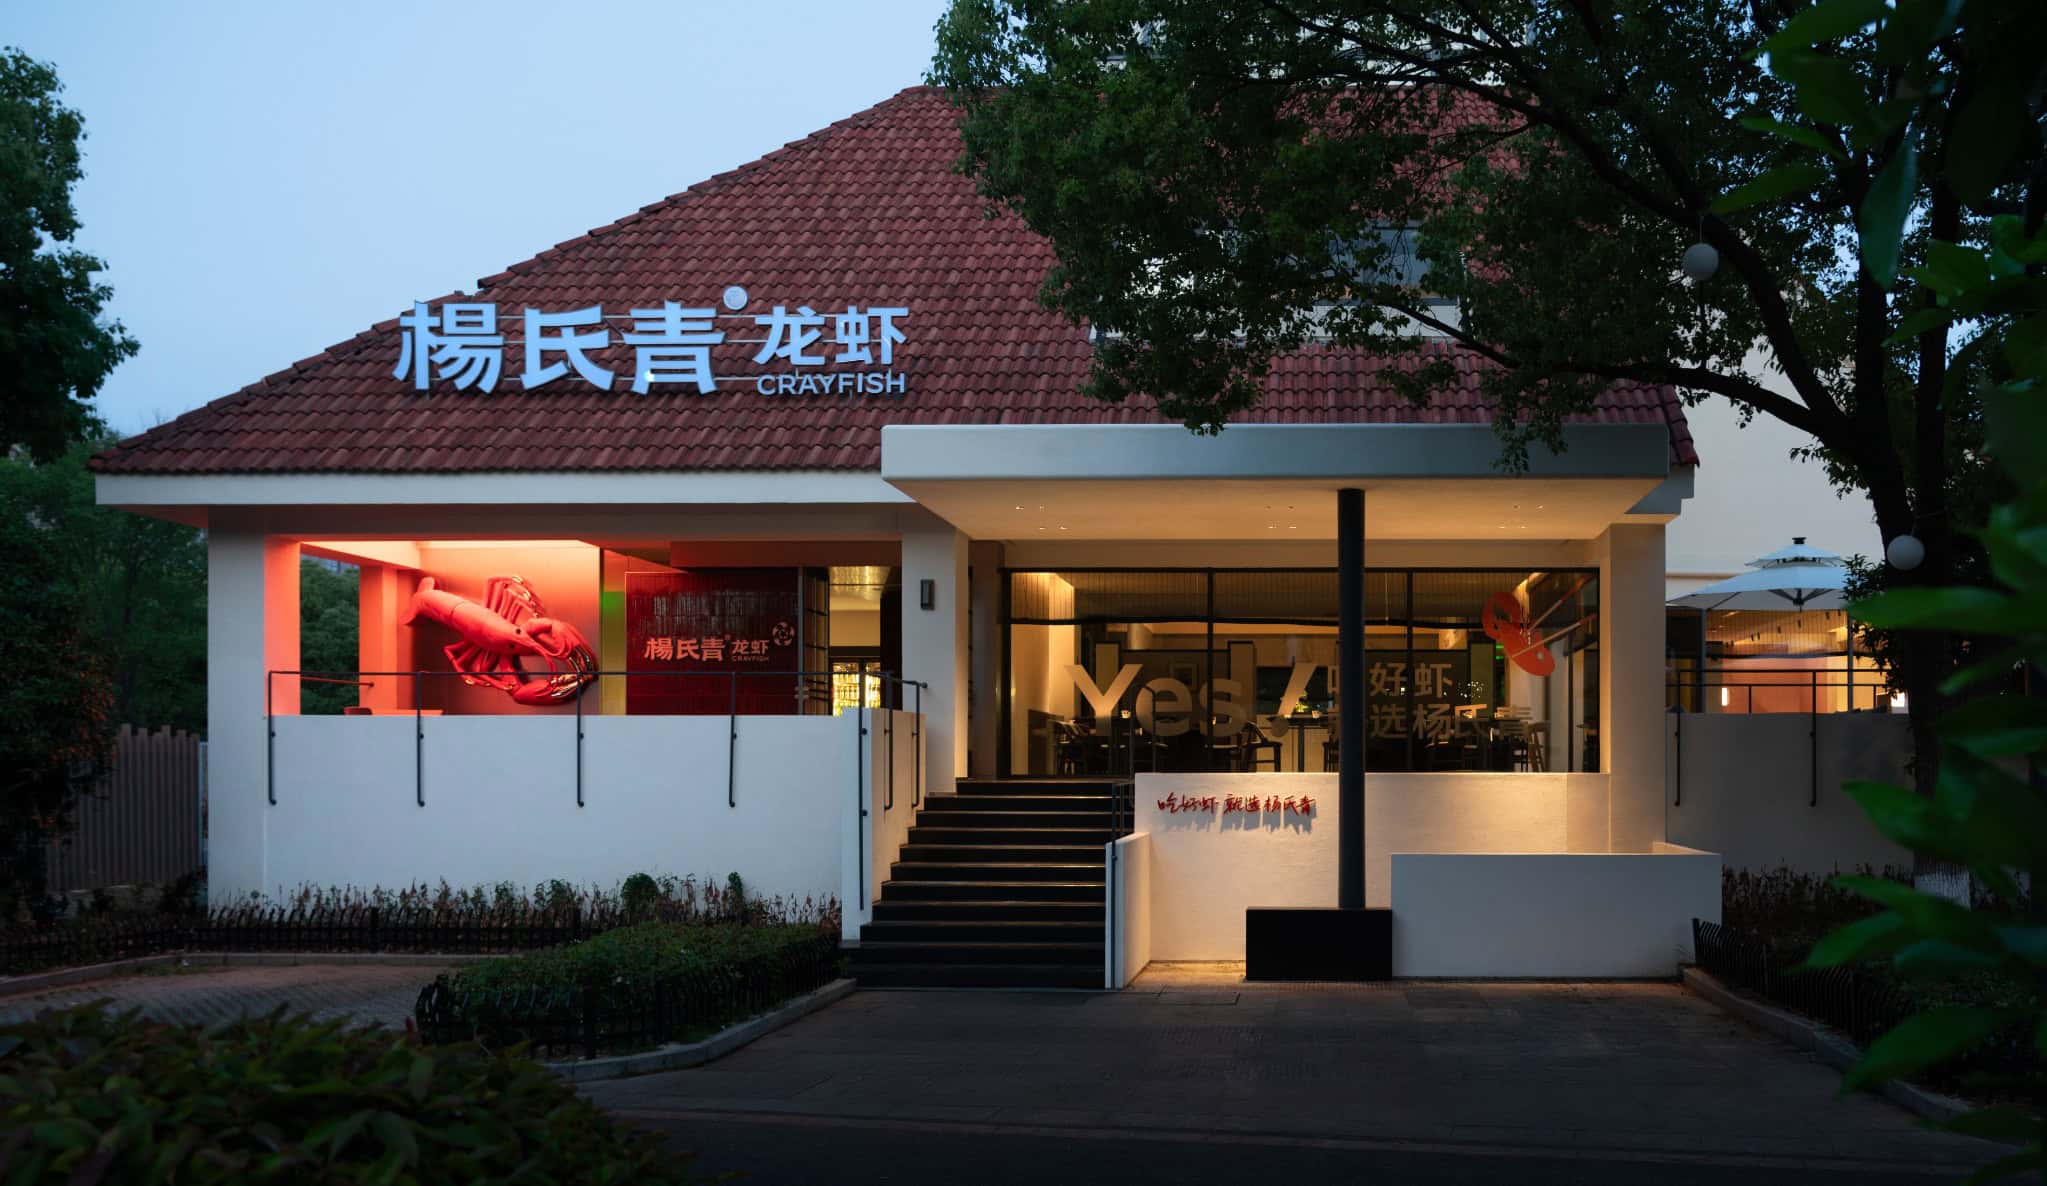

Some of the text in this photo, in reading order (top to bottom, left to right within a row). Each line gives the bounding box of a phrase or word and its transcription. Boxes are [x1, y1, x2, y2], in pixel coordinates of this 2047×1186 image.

[392, 300, 909, 395] 楊氏青 龙虾
[757, 373, 905, 395] CRAYFISH
[644, 637, 769, 661] 楊氏青 龙虾
